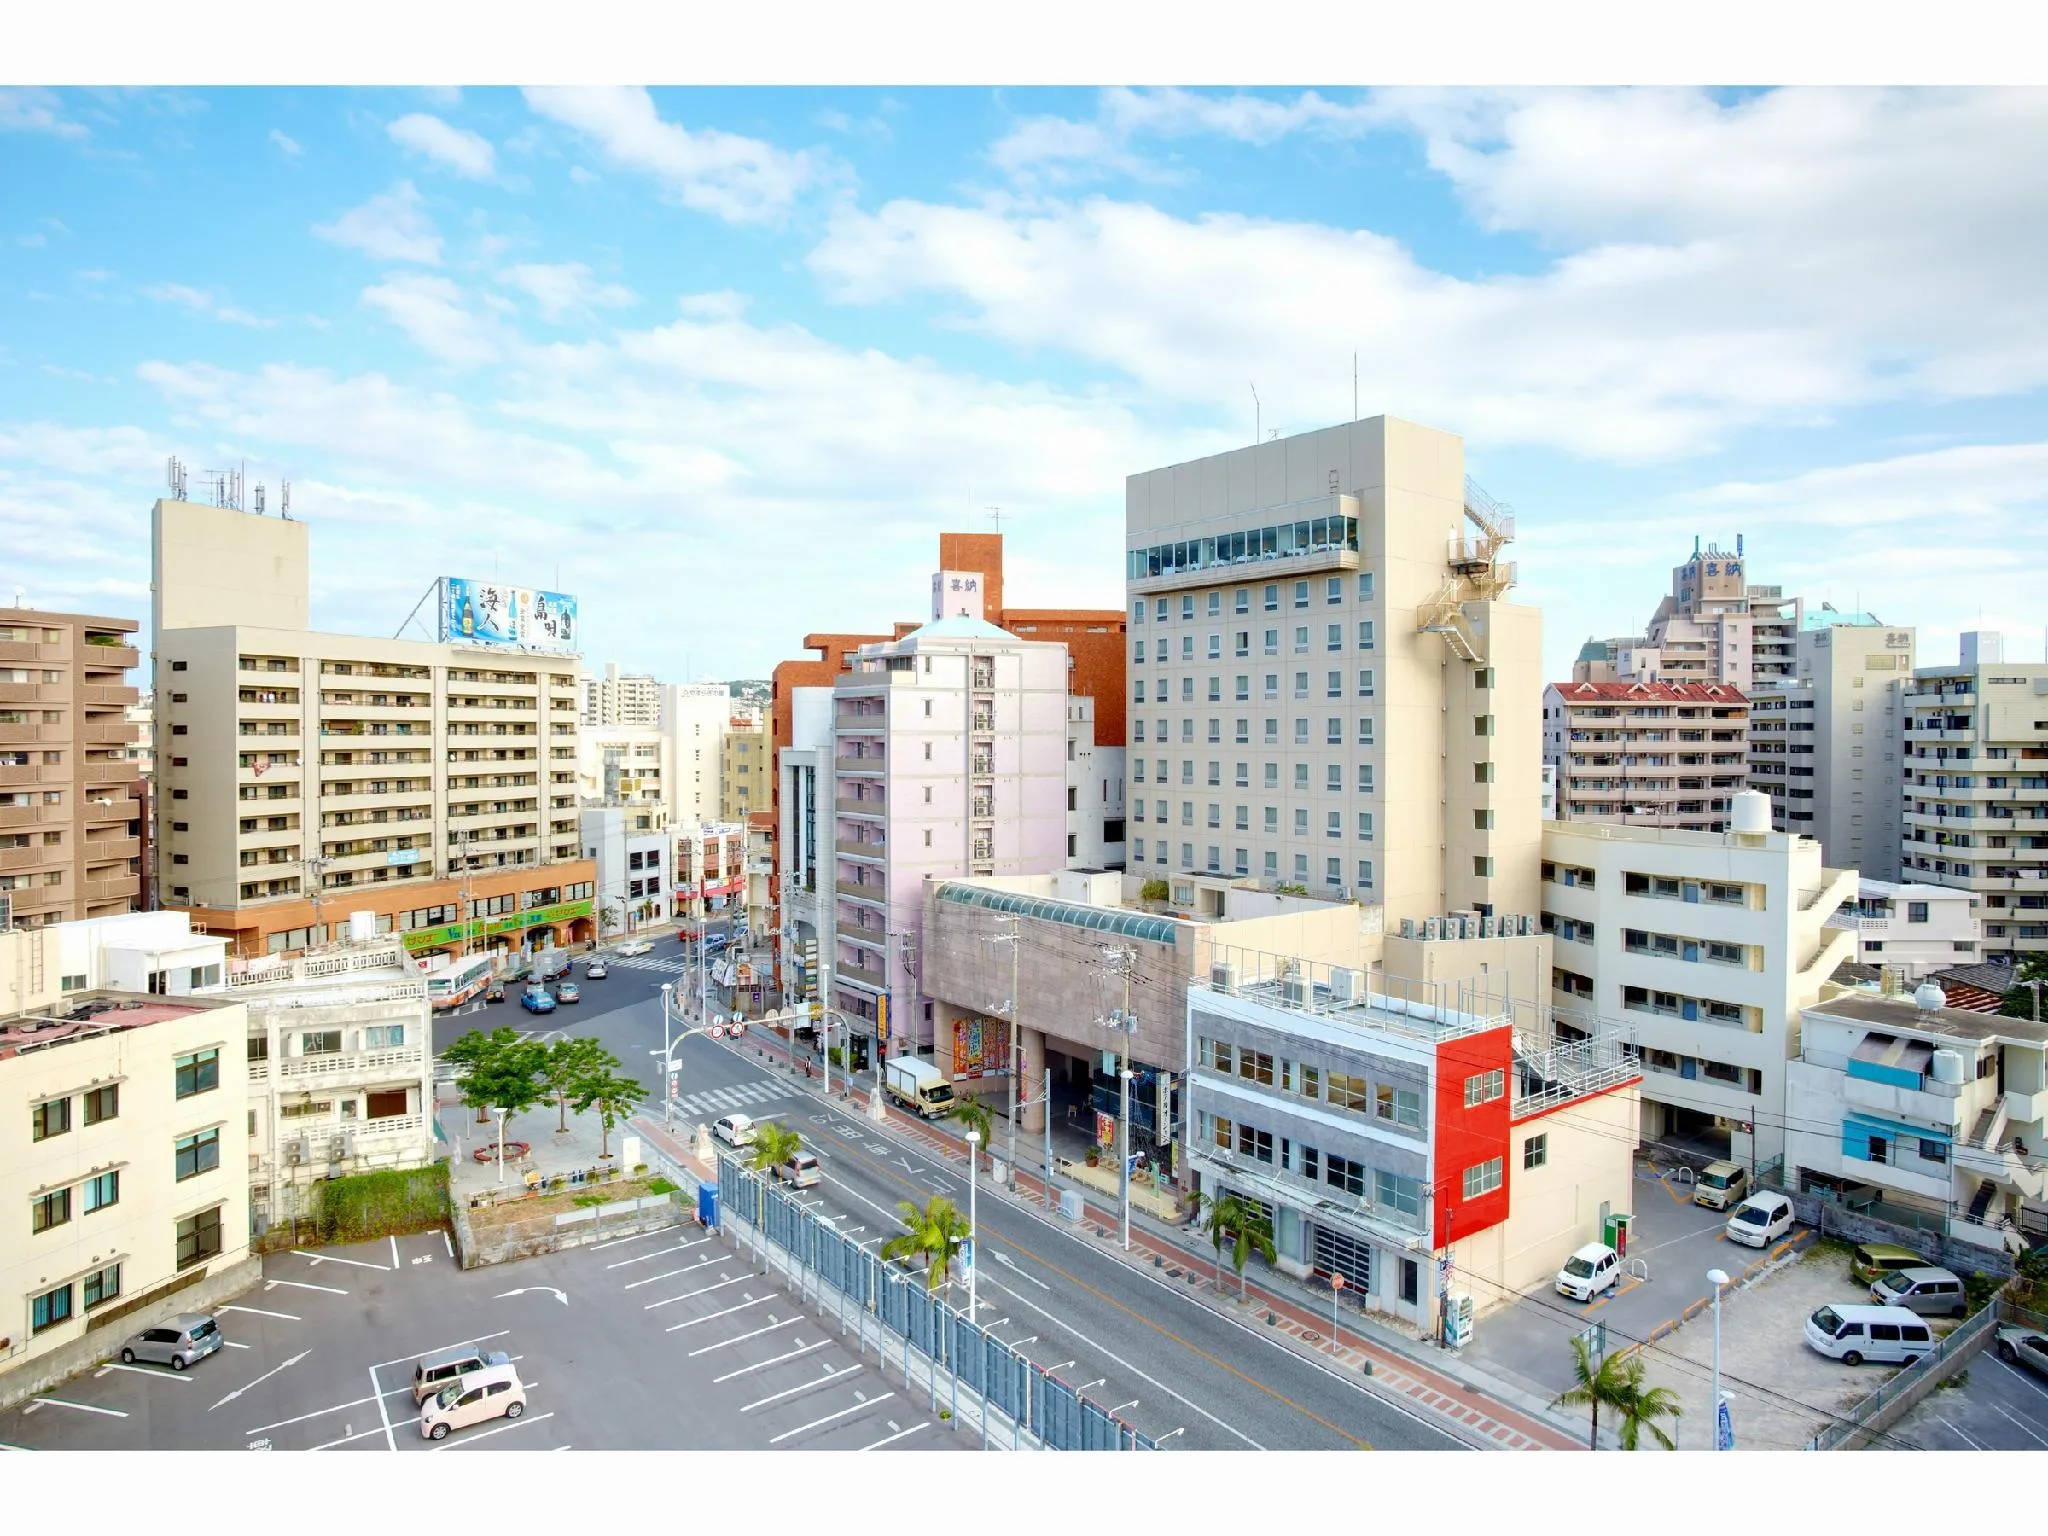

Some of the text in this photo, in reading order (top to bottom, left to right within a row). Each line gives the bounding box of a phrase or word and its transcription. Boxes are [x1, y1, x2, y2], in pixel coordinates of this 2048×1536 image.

[1705, 562, 1741, 577] 喜納
[950, 579, 977, 592] 喜納
[478, 588, 500, 631] 海人
